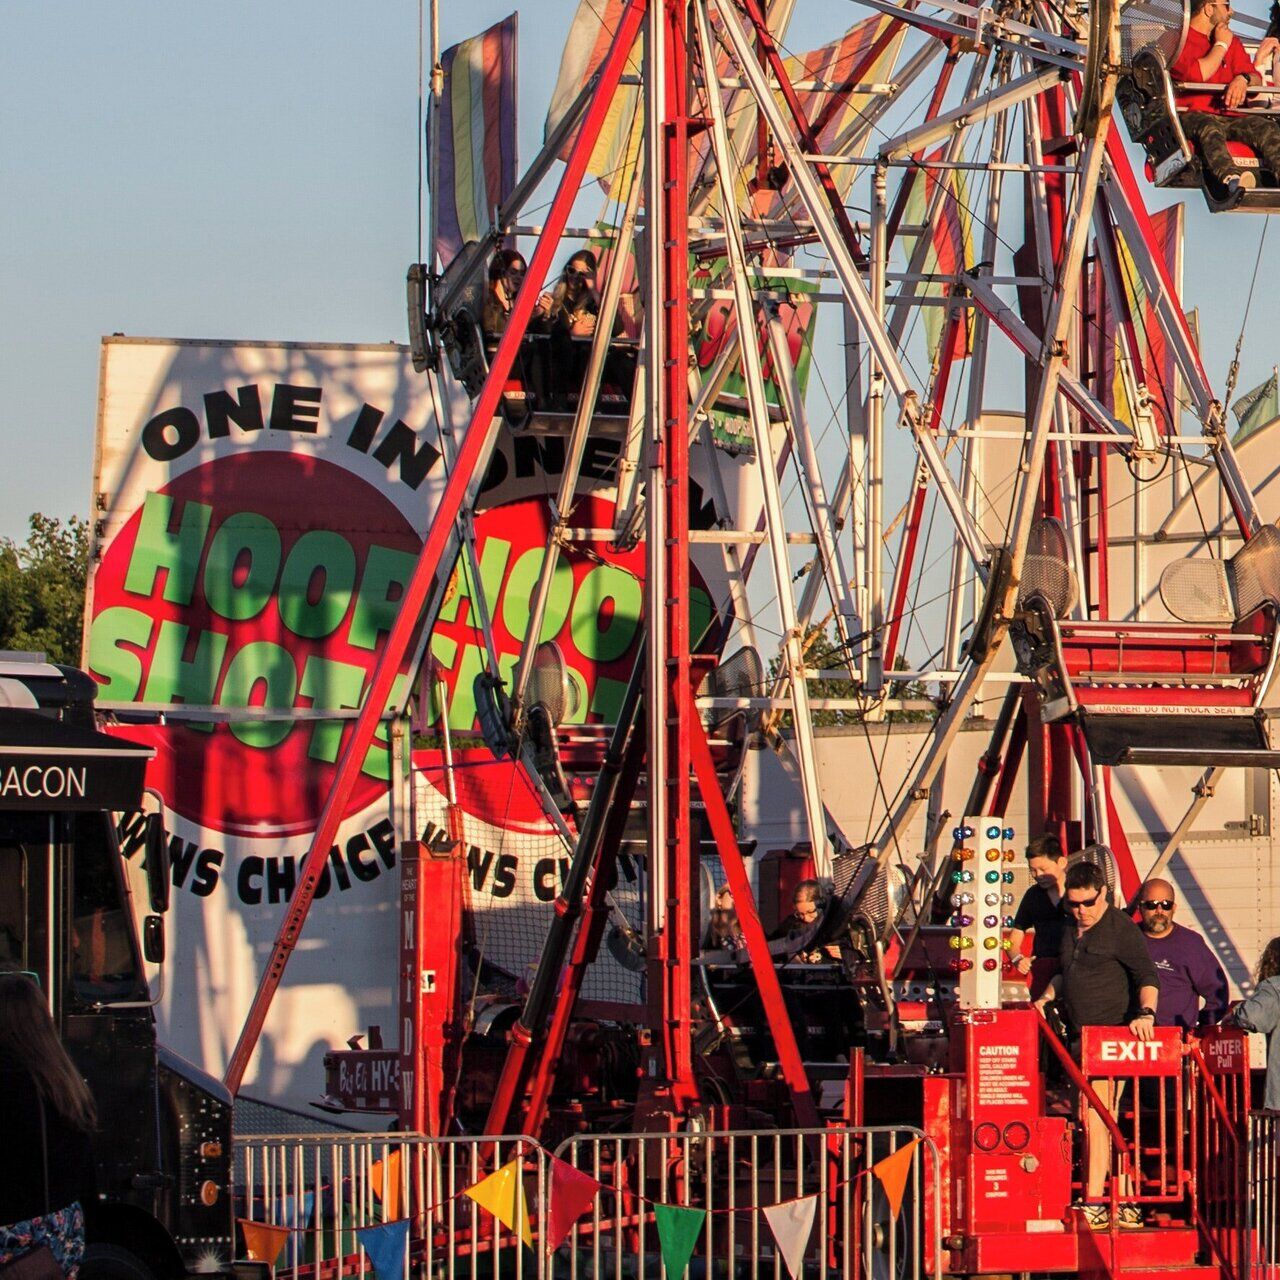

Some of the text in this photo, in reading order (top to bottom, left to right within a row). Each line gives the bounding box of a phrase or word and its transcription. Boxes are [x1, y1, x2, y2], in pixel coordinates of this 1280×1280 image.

[141, 383, 443, 491] ONE IN
[0, 766, 87, 797] ACON
[978, 1045, 1020, 1056] CAUTION
[1101, 1041, 1164, 1062] EXIT
[1209, 1040, 1242, 1055] ENTER
[1217, 1055, 1233, 1068] Pull
